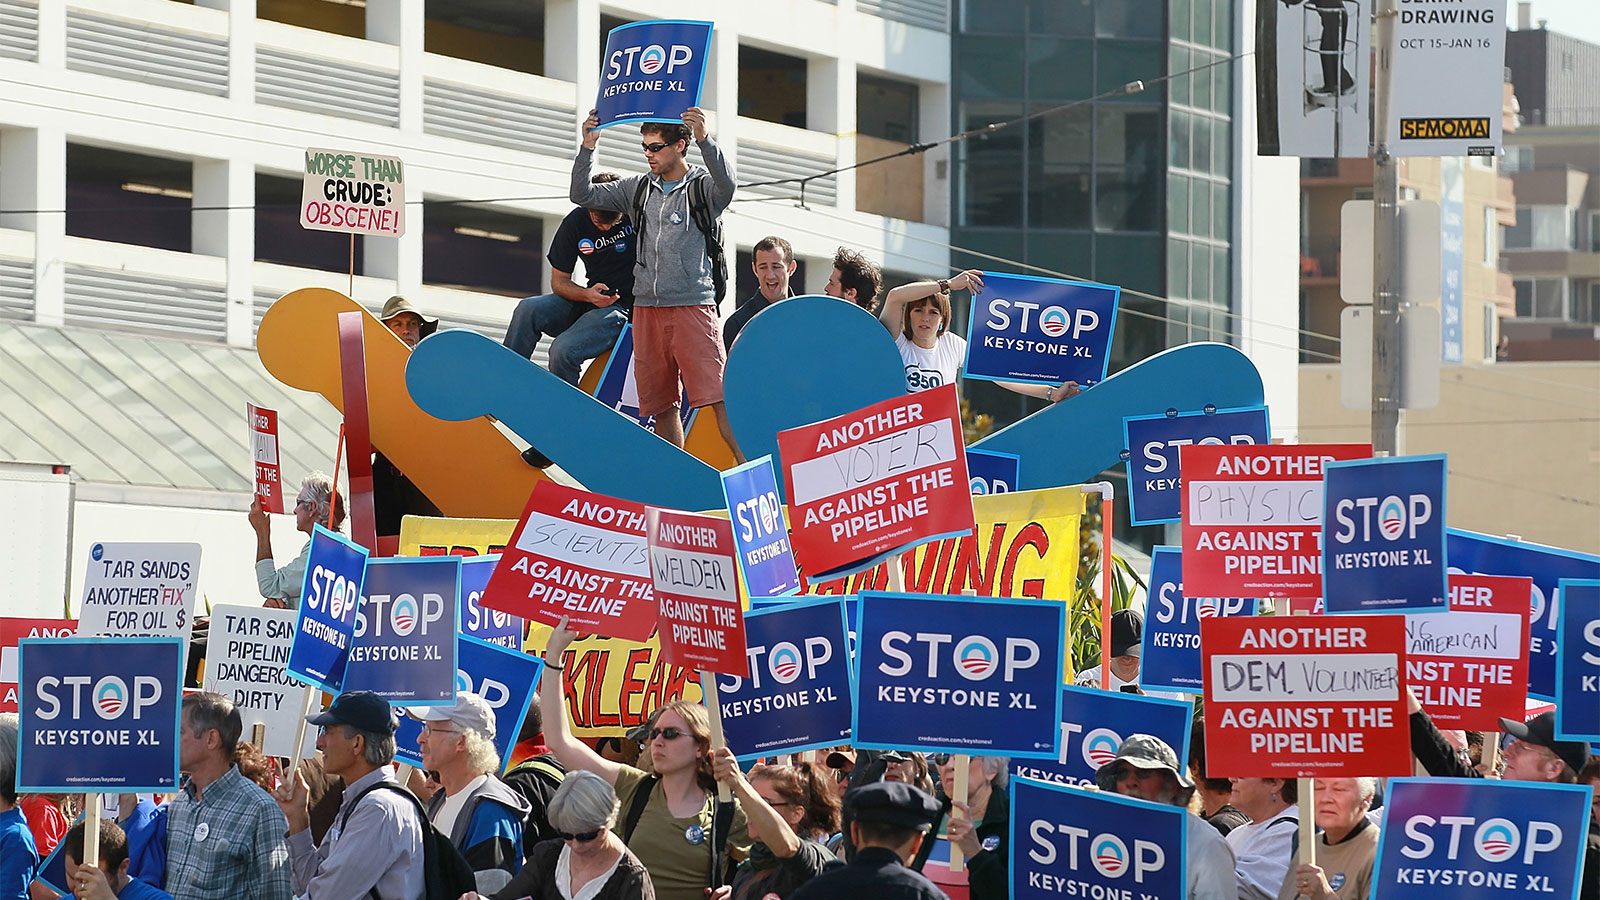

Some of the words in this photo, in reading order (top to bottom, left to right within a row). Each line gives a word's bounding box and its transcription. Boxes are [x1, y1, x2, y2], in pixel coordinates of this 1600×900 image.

[1401, 9, 1494, 24] DRAWING
[1400, 39, 1425, 48] OCT
[1478, 38, 1490, 48] 16
[606, 44, 693, 81] STOP
[603, 80, 662, 98] KEYSTONE
[667, 80, 686, 92] XL
[1402, 118, 1487, 138] SFMOMA
[305, 151, 356, 178] WORSE
[361, 157, 402, 184] THAN
[324, 179, 392, 207] CRUDE:
[306, 201, 399, 234] OBSCENE!
[985, 299, 1099, 340] STOP
[983, 335, 1069, 356] KEYSTONE
[1073, 346, 1093, 358] XL
[907, 371, 940, 389] 350
[816, 402, 923, 453] ANOTHER
[833, 424, 942, 488] VOTER
[803, 481, 899, 528] AGAINST
[906, 467, 954, 495] THE
[1197, 484, 1318, 522] PHYSIC
[561, 498, 647, 532] ANOTH
[736, 491, 779, 543] STOP
[830, 496, 929, 543] PIPELINE
[1335, 493, 1432, 545] STOP
[530, 523, 648, 566] SCIENTIS
[659, 522, 718, 549] ANOTHER
[1196, 531, 1304, 552] AGAINST
[746, 541, 781, 567] KEYSTONE
[779, 538, 788, 554] XL
[1335, 550, 1409, 570] KEYSTONE
[1413, 548, 1432, 566] XL
[103, 560, 135, 578] TAR
[140, 560, 191, 581] SANDS
[511, 556, 614, 593] AGAINST
[618, 580, 654, 601] THE
[653, 552, 726, 592] WELDER
[86, 587, 159, 605] ANOTHER
[307, 564, 356, 623] STOP
[528, 582, 627, 617] PIPELINE
[106, 611, 138, 630] FOR
[142, 611, 167, 630] OIL
[175, 608, 186, 630] $
[225, 615, 261, 636] TAR
[266, 619, 296, 639] SAN
[353, 593, 444, 637] STOP
[659, 597, 710, 625] AGAINST
[712, 606, 738, 628] THE
[302, 616, 337, 647] KEYSTONE
[336, 632, 346, 650] XL
[672, 623, 726, 651] PIPELINE
[1153, 632, 1201, 649] KEYSTO
[1239, 628, 1367, 649] ANOTHER
[348, 645, 419, 662] KEYSTONE
[423, 645, 442, 660] XL
[878, 630, 1040, 683] STOP
[1222, 660, 1294, 695] DEM.
[1302, 664, 1400, 694] VOLUNTEER
[1462, 663, 1513, 685] THE
[34, 675, 162, 721] STOP
[234, 689, 284, 711] DIRTY
[722, 690, 810, 719] KEYSTONE
[815, 686, 837, 703] XL
[878, 686, 1000, 708] KEYSTONE
[1008, 692, 1037, 710] XL
[1412, 685, 1482, 708] ELINE
[1219, 707, 1336, 729] AGAINST
[1342, 707, 1394, 728] THE
[34, 730, 130, 746] KEYSTONE
[137, 730, 160, 746] XL
[1250, 732, 1364, 754] PIPELINE
[1028, 819, 1166, 884] STOP
[1400, 814, 1563, 865] STOP
[1029, 871, 1133, 900] KEYSTONE
[1396, 868, 1518, 890] KEYSTONE
[1526, 875, 1555, 892] XL
